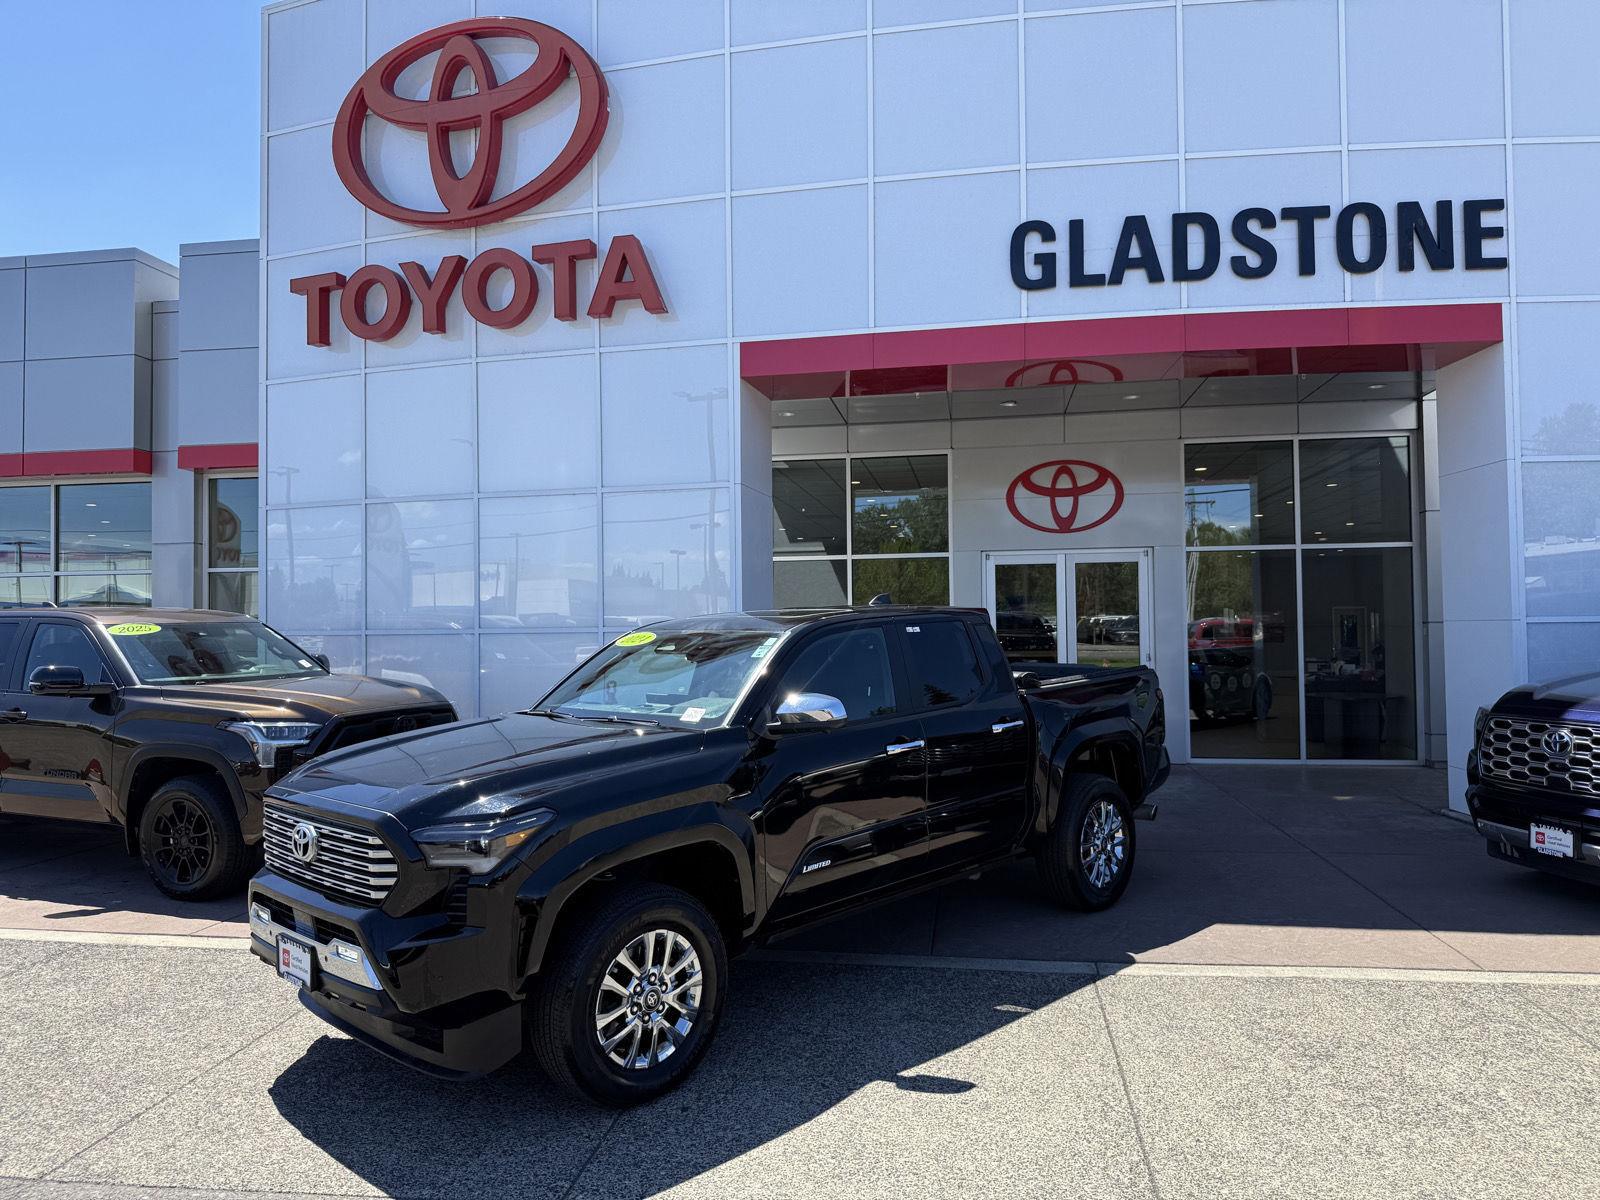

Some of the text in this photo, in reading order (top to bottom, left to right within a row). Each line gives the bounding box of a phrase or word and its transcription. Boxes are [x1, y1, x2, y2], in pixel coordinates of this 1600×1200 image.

[1009, 198, 1508, 290] GLADSTONE
[289, 234, 669, 348] TOYOTA
[118, 625, 152, 634] 2025
[802, 859, 832, 874] LIMITED
